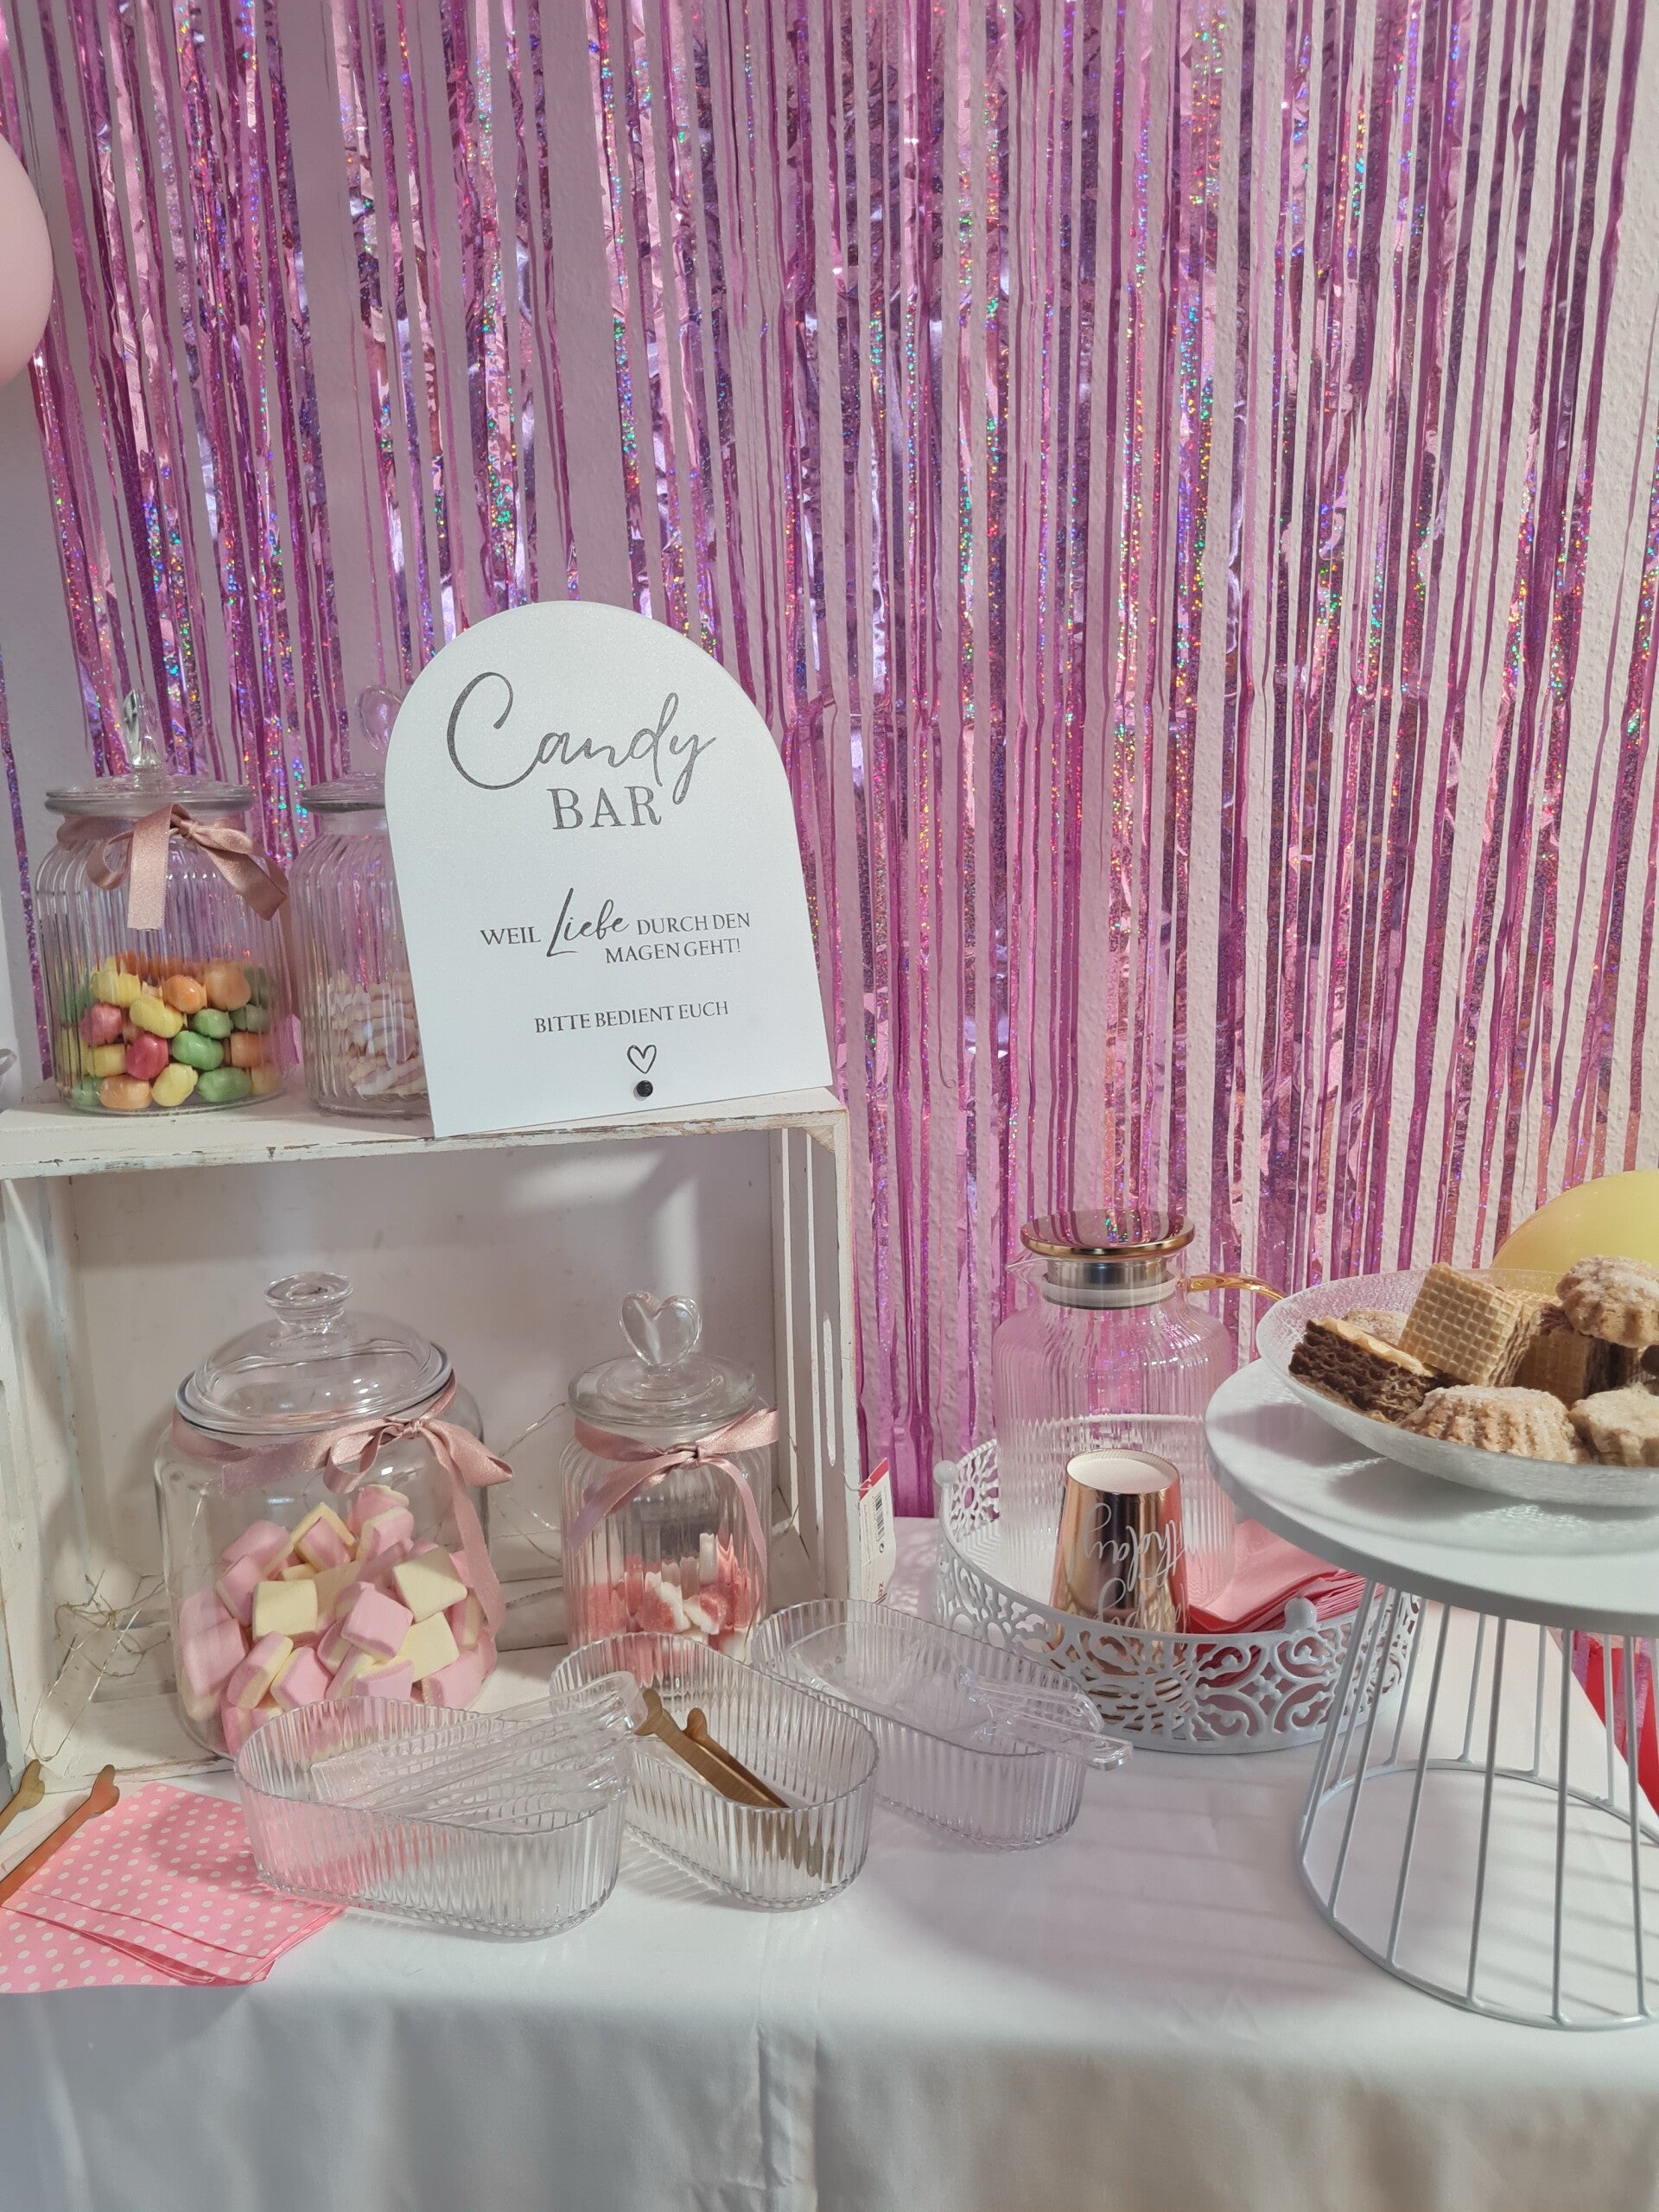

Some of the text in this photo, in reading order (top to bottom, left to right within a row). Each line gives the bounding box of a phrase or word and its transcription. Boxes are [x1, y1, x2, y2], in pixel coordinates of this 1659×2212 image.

[446, 671, 716, 805] Candy
[546, 785, 663, 830] BAR
[480, 887, 751, 957] WEIL Liebe DURCH DEN
[605, 938, 742, 964] MAGEN GEHT!
[533, 1001, 729, 1033] BITTE BEDIENT EUCH
